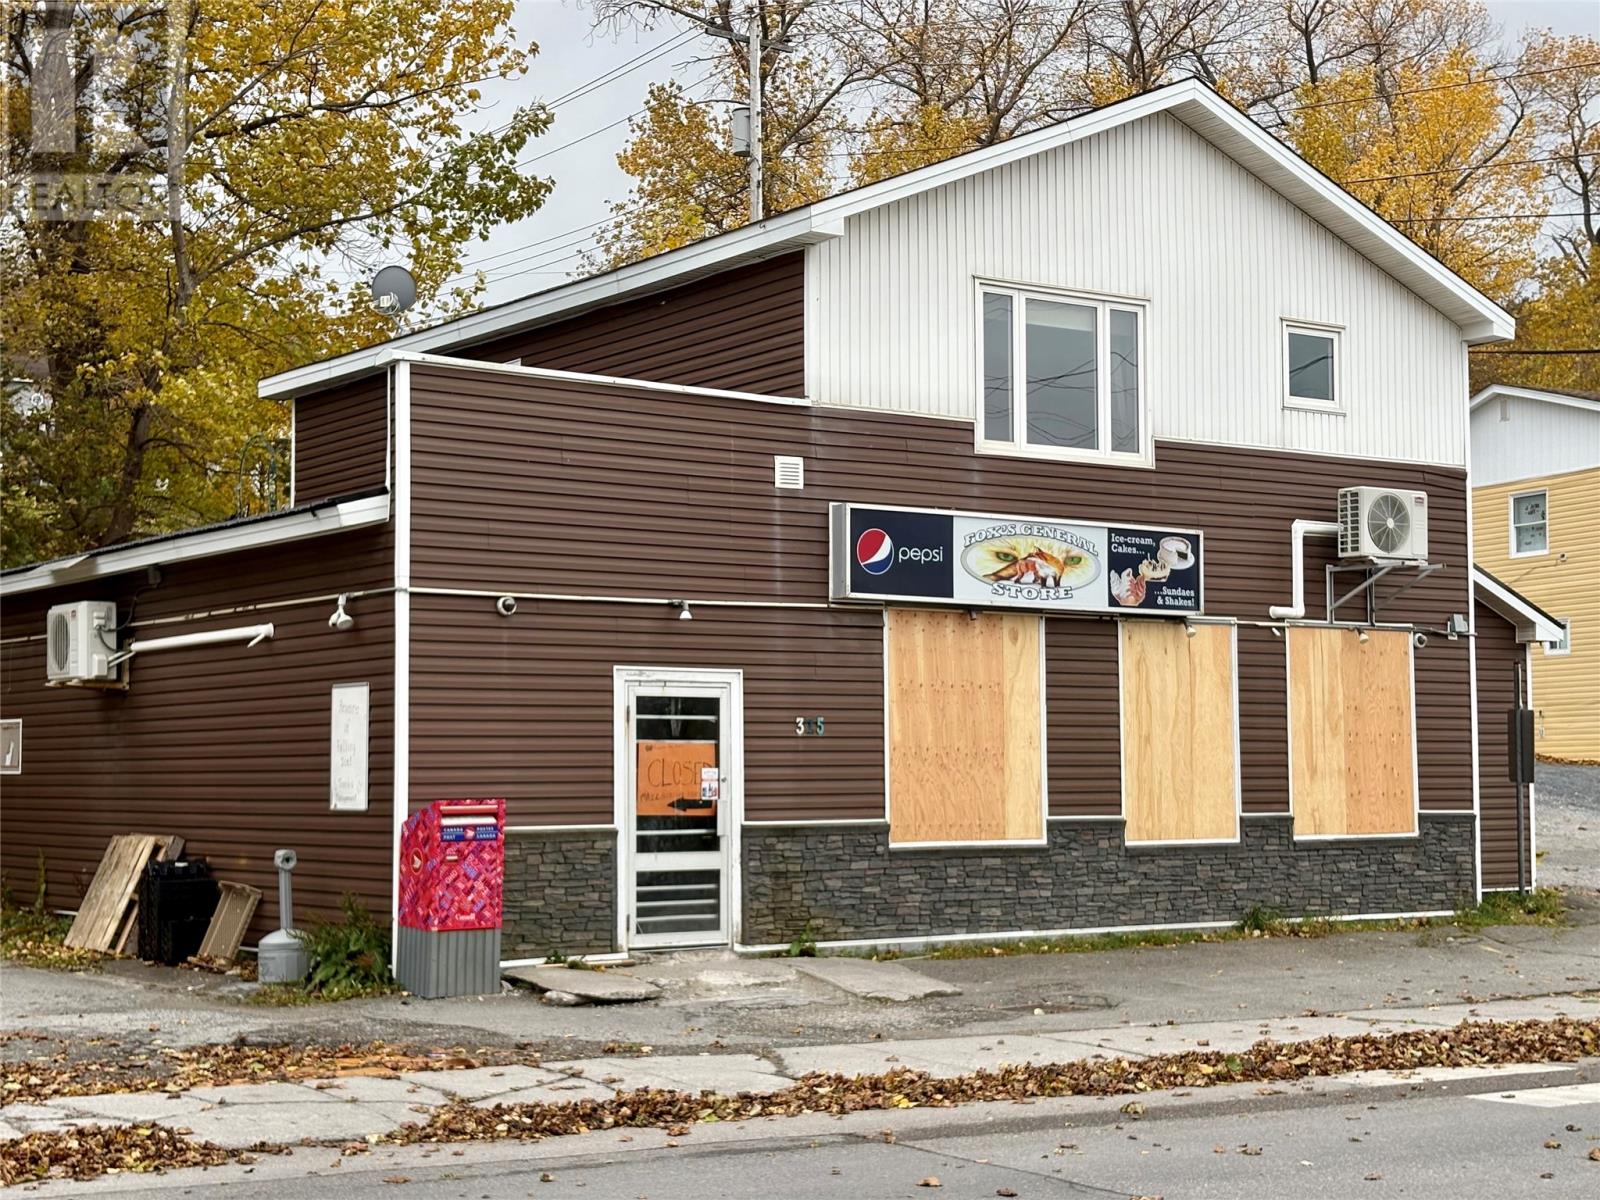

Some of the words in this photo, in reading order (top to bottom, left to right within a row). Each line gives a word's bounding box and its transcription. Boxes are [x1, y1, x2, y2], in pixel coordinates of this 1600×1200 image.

[963, 524, 1017, 548] FOX'S
[1020, 524, 1099, 556] GENERAL
[1111, 533, 1156, 547] Ice-cream,
[898, 546, 944, 564] pepsi
[1111, 544, 1145, 555] Cakes...
[991, 582, 1074, 600] STORE
[1157, 596, 1164, 605] &
[1165, 596, 1195, 607] Shakes!
[647, 757, 714, 788] CLOSE
